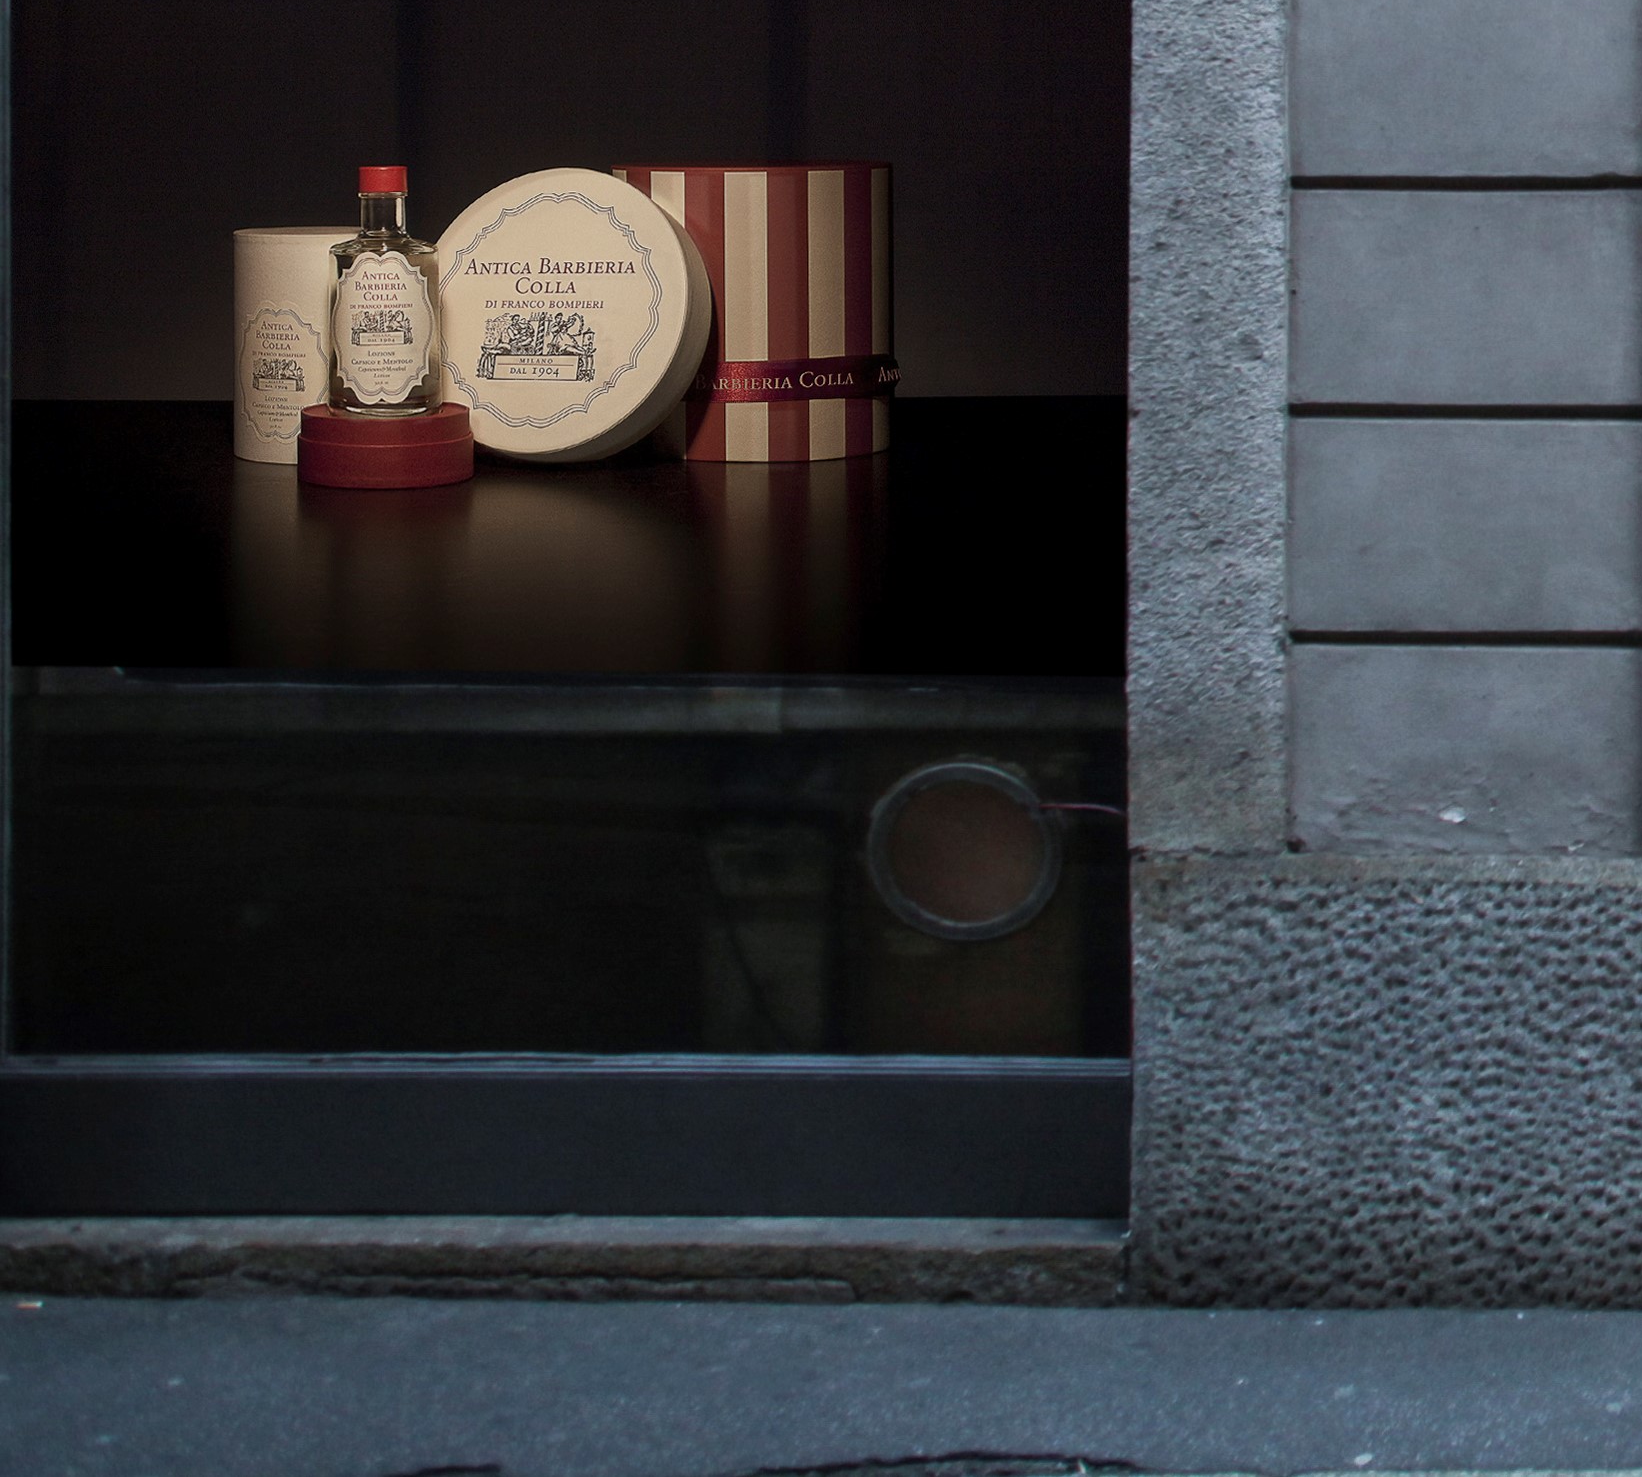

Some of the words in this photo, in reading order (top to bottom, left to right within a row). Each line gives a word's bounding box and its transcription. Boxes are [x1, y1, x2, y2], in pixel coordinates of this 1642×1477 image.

[464, 258, 532, 275] ANTICA
[538, 257, 636, 274] BARBIERIA
[361, 271, 400, 280] ANTICA
[355, 281, 407, 291] BARBIERIA
[515, 276, 577, 295] COLLA
[363, 291, 399, 302] COLLA
[485, 300, 497, 309] DI
[501, 300, 545, 309] FRANCO
[549, 300, 604, 309] BOMPIERI
[260, 321, 294, 331] ANTICA
[256, 330, 300, 341] BARBIERIA
[262, 340, 291, 351] COLLA
[531, 367, 560, 378] 1904
[799, 370, 854, 388] COLLA
